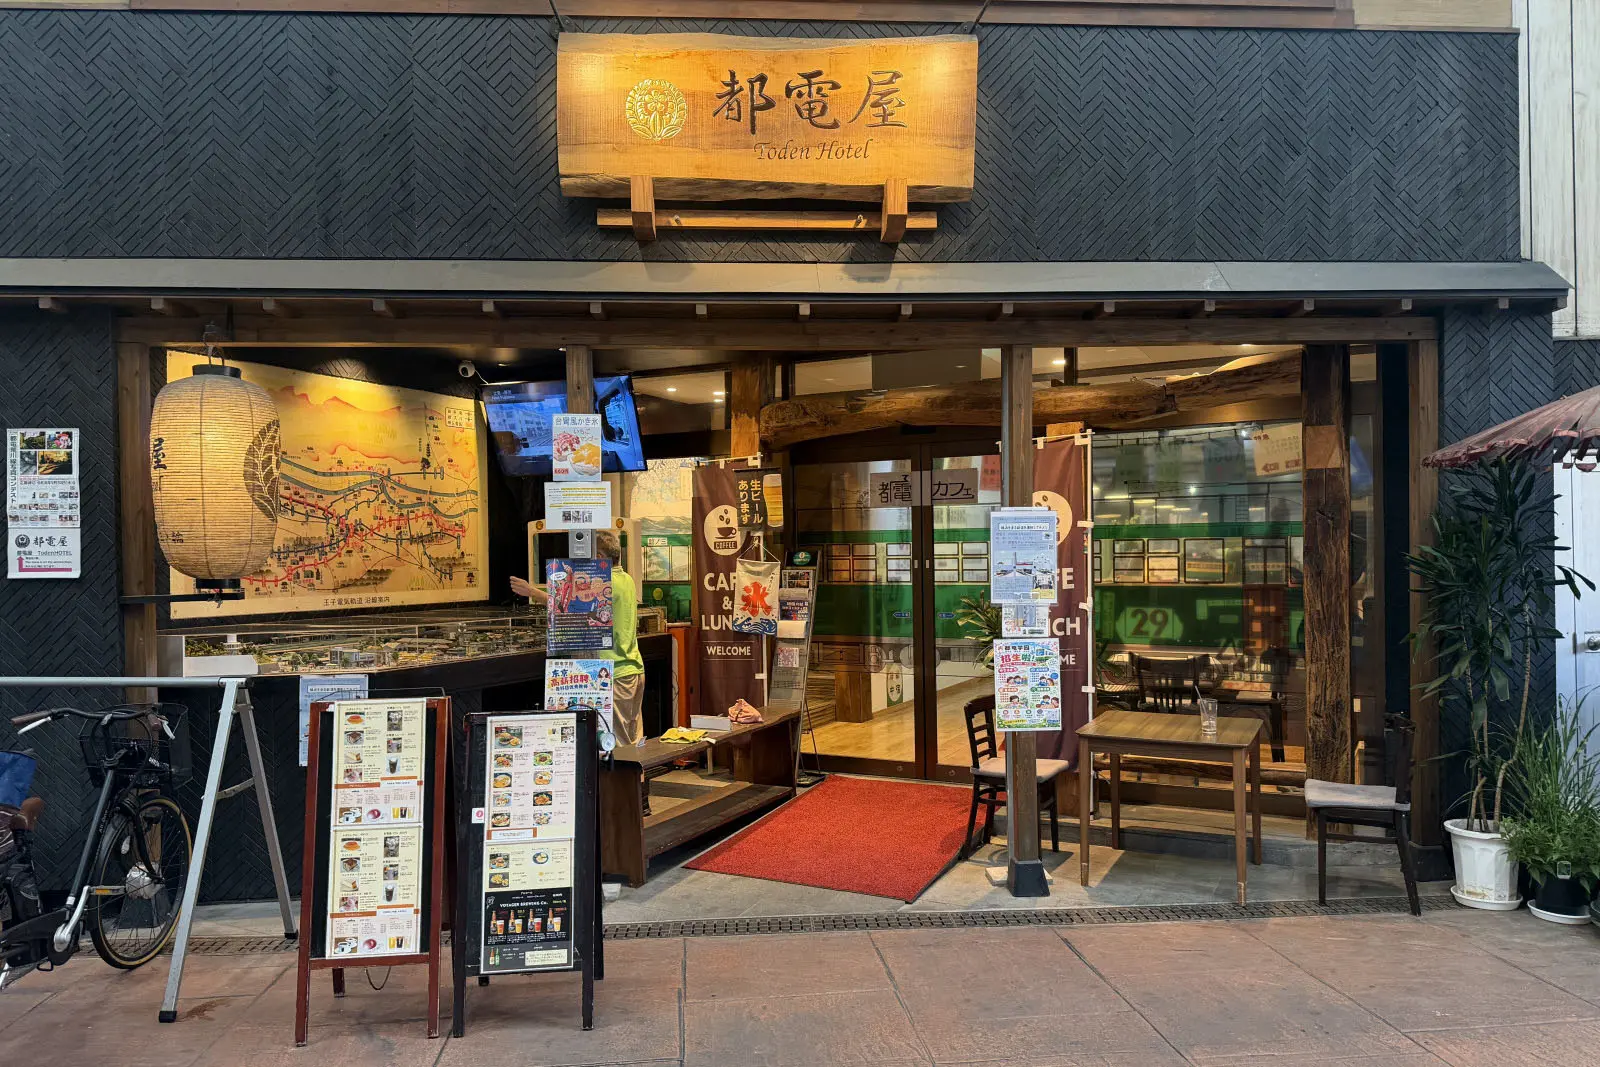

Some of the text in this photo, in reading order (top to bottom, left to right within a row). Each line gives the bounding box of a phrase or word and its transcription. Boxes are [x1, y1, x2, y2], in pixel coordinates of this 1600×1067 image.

[711, 69, 908, 135] 都電屋
[753, 138, 873, 161] Toden Hotel
[932, 480, 973, 497] カフェ
[738, 479, 750, 524] あります
[750, 479, 763, 524] 生ビール
[33, 535, 68, 547] 都電屋
[715, 541, 736, 549] COFFEE
[703, 572, 737, 592] CAF
[722, 596, 733, 610] &
[740, 581, 773, 617] 氷
[701, 614, 733, 631] LUN
[1131, 608, 1169, 638] 29
[706, 645, 751, 656] WELCOME
